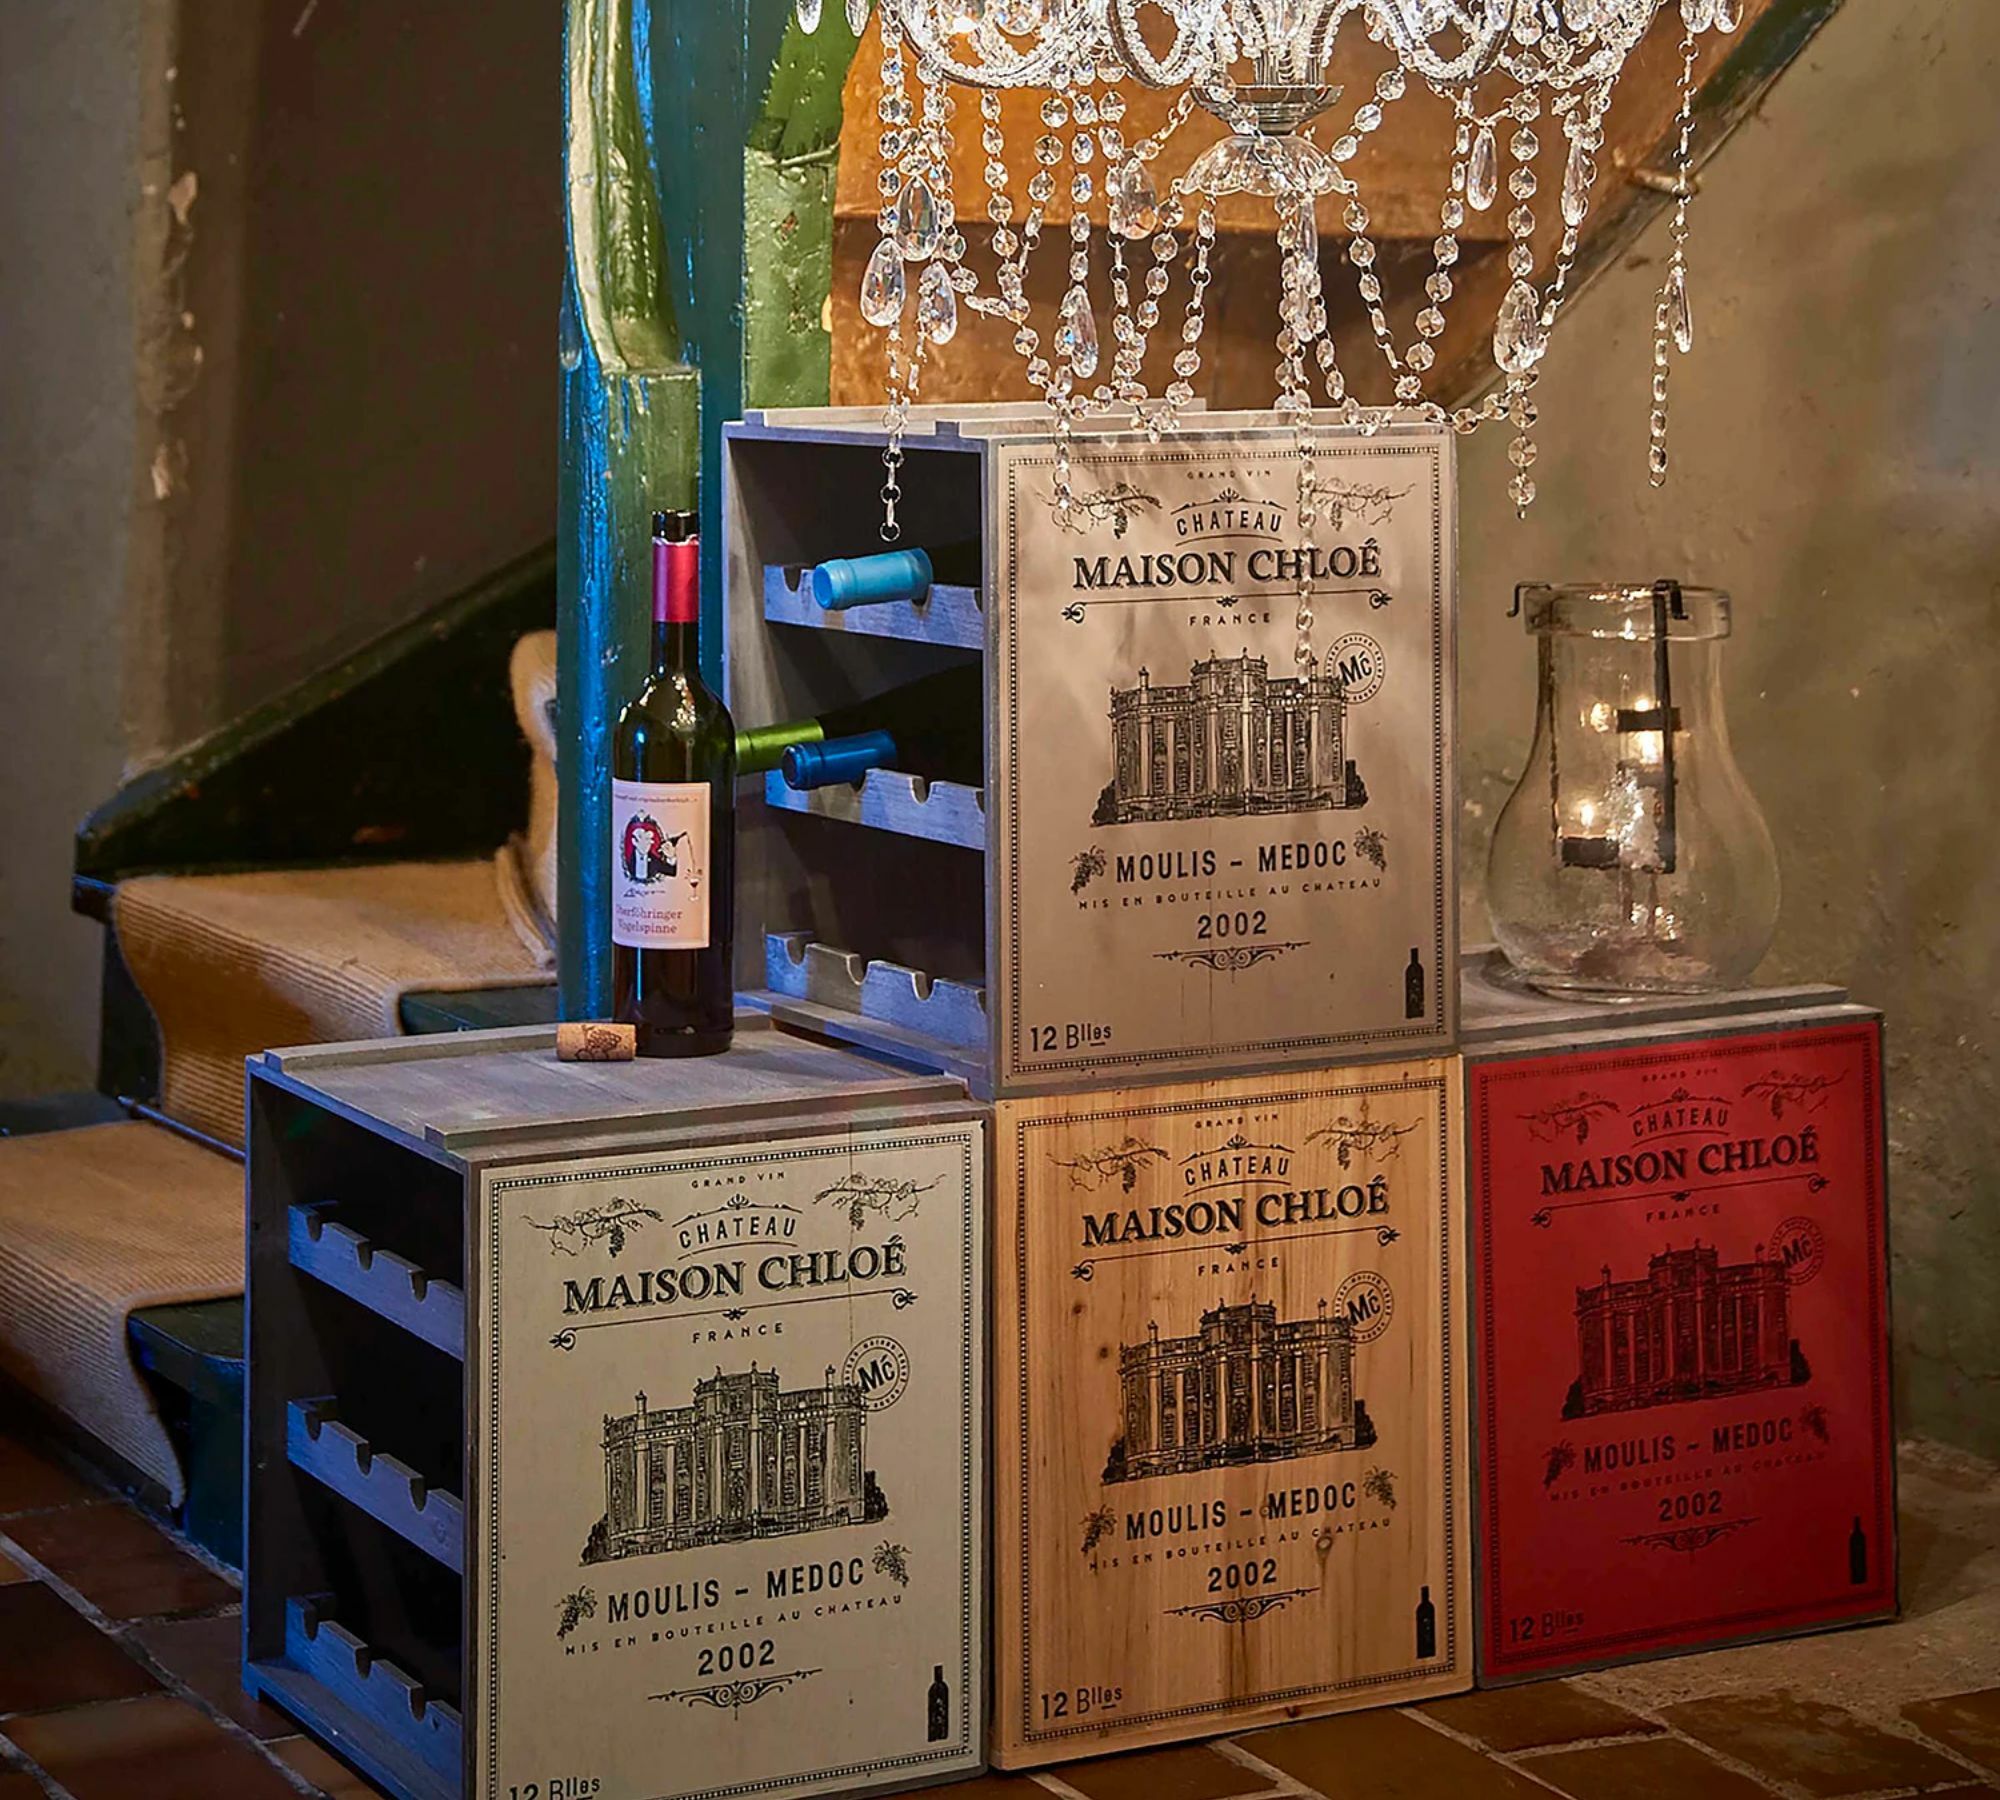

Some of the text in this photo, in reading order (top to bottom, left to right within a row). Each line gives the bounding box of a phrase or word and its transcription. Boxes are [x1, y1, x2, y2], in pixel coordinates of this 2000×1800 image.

[1176, 510, 1282, 536] CHATEAU
[1073, 538, 1381, 589] MAISON CHLOÉ
[1189, 612, 1271, 627] FRANCE
[1116, 850, 1216, 883] MOULIS
[1258, 840, 1347, 872] MEDOC
[1156, 888, 1256, 904] BOUTEILLE
[1269, 885, 1290, 895] AU
[1302, 879, 1381, 893] CHATEAU
[1197, 911, 1267, 939] 2002
[1030, 1025, 1057, 1052] 12
[1633, 1107, 1728, 1137] CHATEAU
[1185, 1156, 1289, 1185] CHATEAU
[1541, 1124, 1819, 1196] MAISON CHLOÉ
[692, 1171, 785, 1188] GRAND VIN
[1082, 1174, 1389, 1247] MAISON CHLOÉ
[1647, 1204, 1720, 1223] FRANCE
[679, 1217, 796, 1249] CHATEAU
[562, 1235, 908, 1314] MAISON CHLOÉ
[1198, 1257, 1279, 1277] FRANCE
[692, 1323, 784, 1344] FRANCE
[1584, 1436, 1675, 1474] MOULIS
[1713, 1418, 1793, 1453] MEDOC
[1126, 1501, 1226, 1541] MOULIS
[1267, 1483, 1356, 1520] MEDOC
[1659, 1491, 1722, 1521] 2002
[1166, 1536, 1266, 1560] BOUTEILLE
[1279, 1532, 1300, 1542] AU
[1312, 1518, 1391, 1538] CHATEAU
[608, 1580, 719, 1623] MOULIS
[767, 1557, 865, 1599] MEDOC
[1208, 1558, 1277, 1592] 2002
[566, 1594, 902, 1655] MIS EN BOUTEILLE AU CHATEAU
[1510, 1617, 1533, 1642] 12
[698, 1639, 776, 1676] 2002
[1041, 1691, 1068, 1719] 12
[509, 1783, 538, 1800] 12
